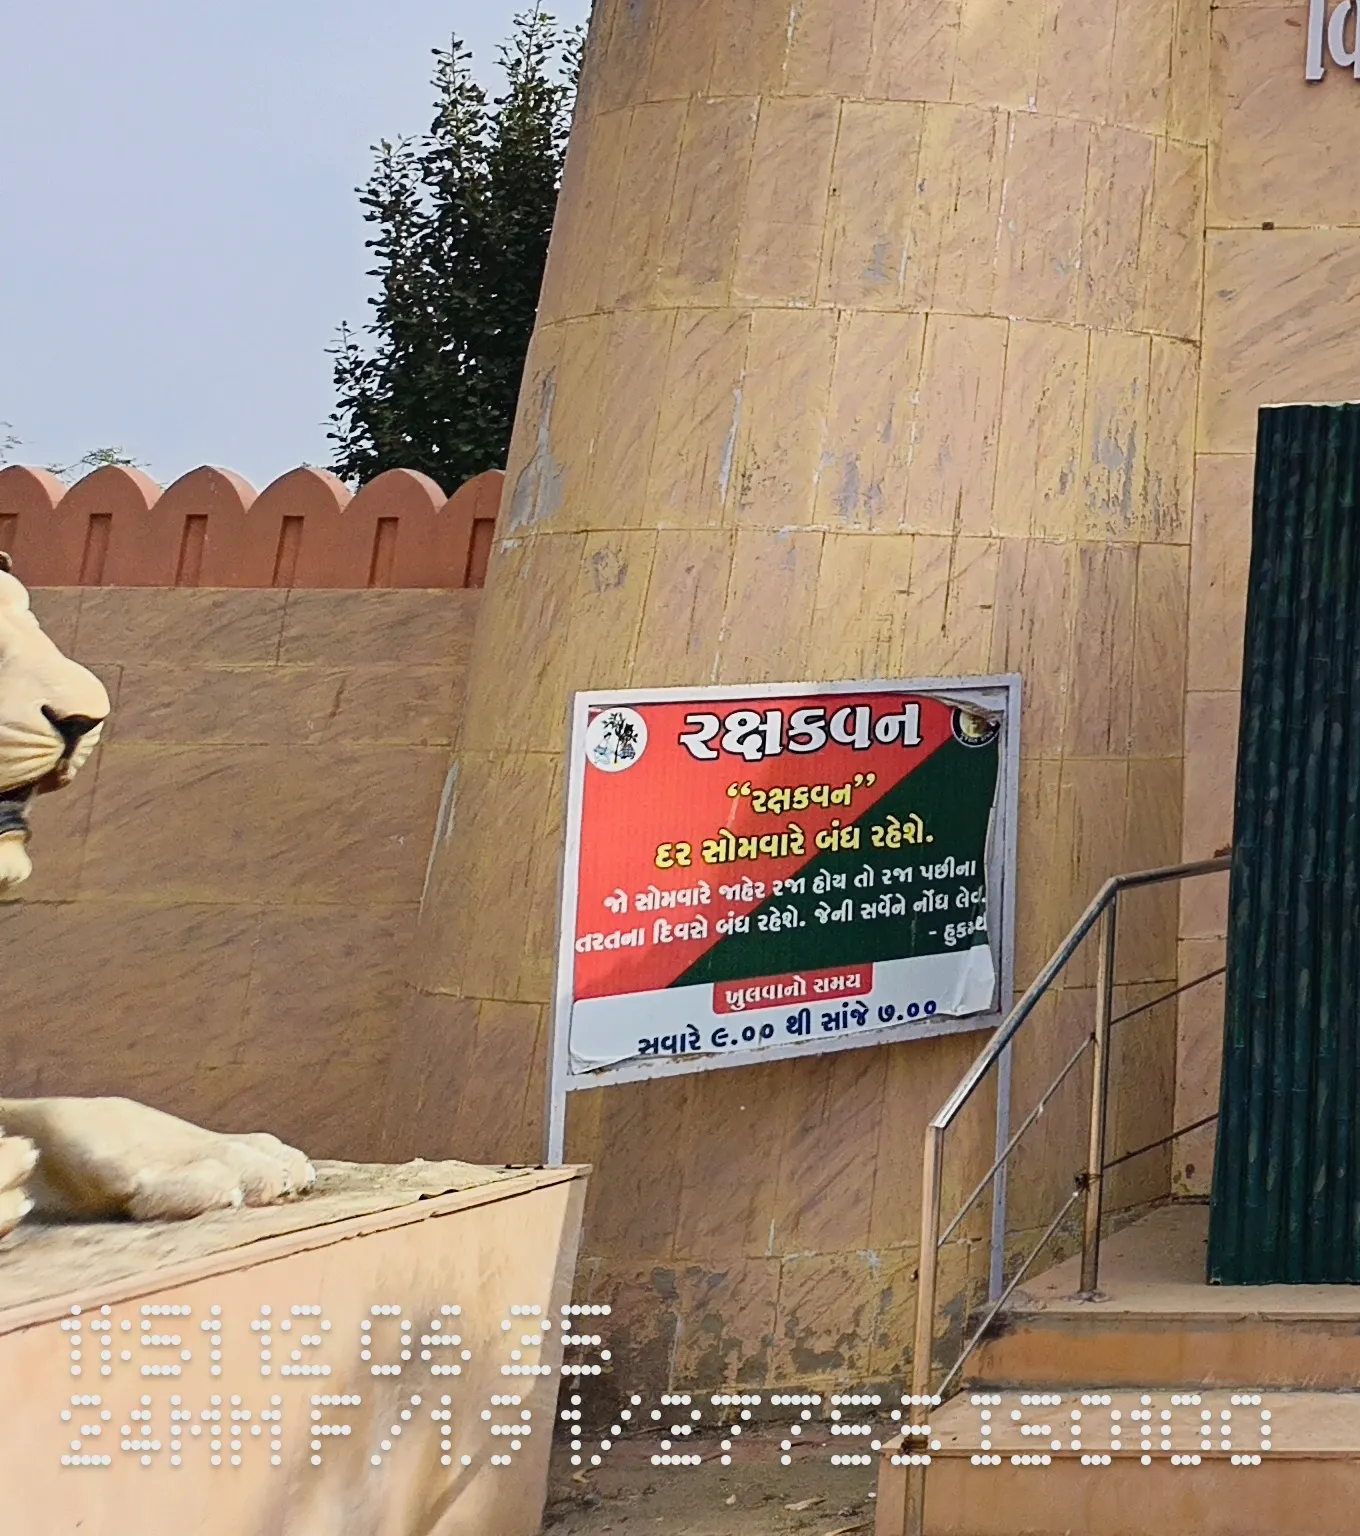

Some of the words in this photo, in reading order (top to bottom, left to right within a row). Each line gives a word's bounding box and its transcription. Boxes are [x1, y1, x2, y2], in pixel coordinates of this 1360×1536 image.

[678, 703, 923, 762] રક્ષકવન
[655, 841, 692, 868] દર
[701, 823, 805, 863] સોમવારે
[815, 819, 861, 852] બંધ
[871, 814, 934, 848] રહેશે.
[603, 888, 629, 914] જો
[635, 880, 712, 912] સોમવારે
[718, 876, 766, 902] જાહેર
[772, 876, 806, 897] રજા
[811, 868, 847, 895] હોય
[853, 864, 875, 888] તો
[881, 866, 913, 885] રજા
[920, 856, 977, 881] પછીના
[575, 928, 646, 953] તરતના
[652, 914, 709, 945] દિવસે
[757, 905, 806, 932] રહેશે.
[814, 899, 853, 925] જેની
[725, 975, 807, 1011] ખુલવાનો
[638, 1023, 701, 1056] સવારે
[786, 1008, 812, 1037] થી
[821, 1000, 869, 1033] સાંજે
